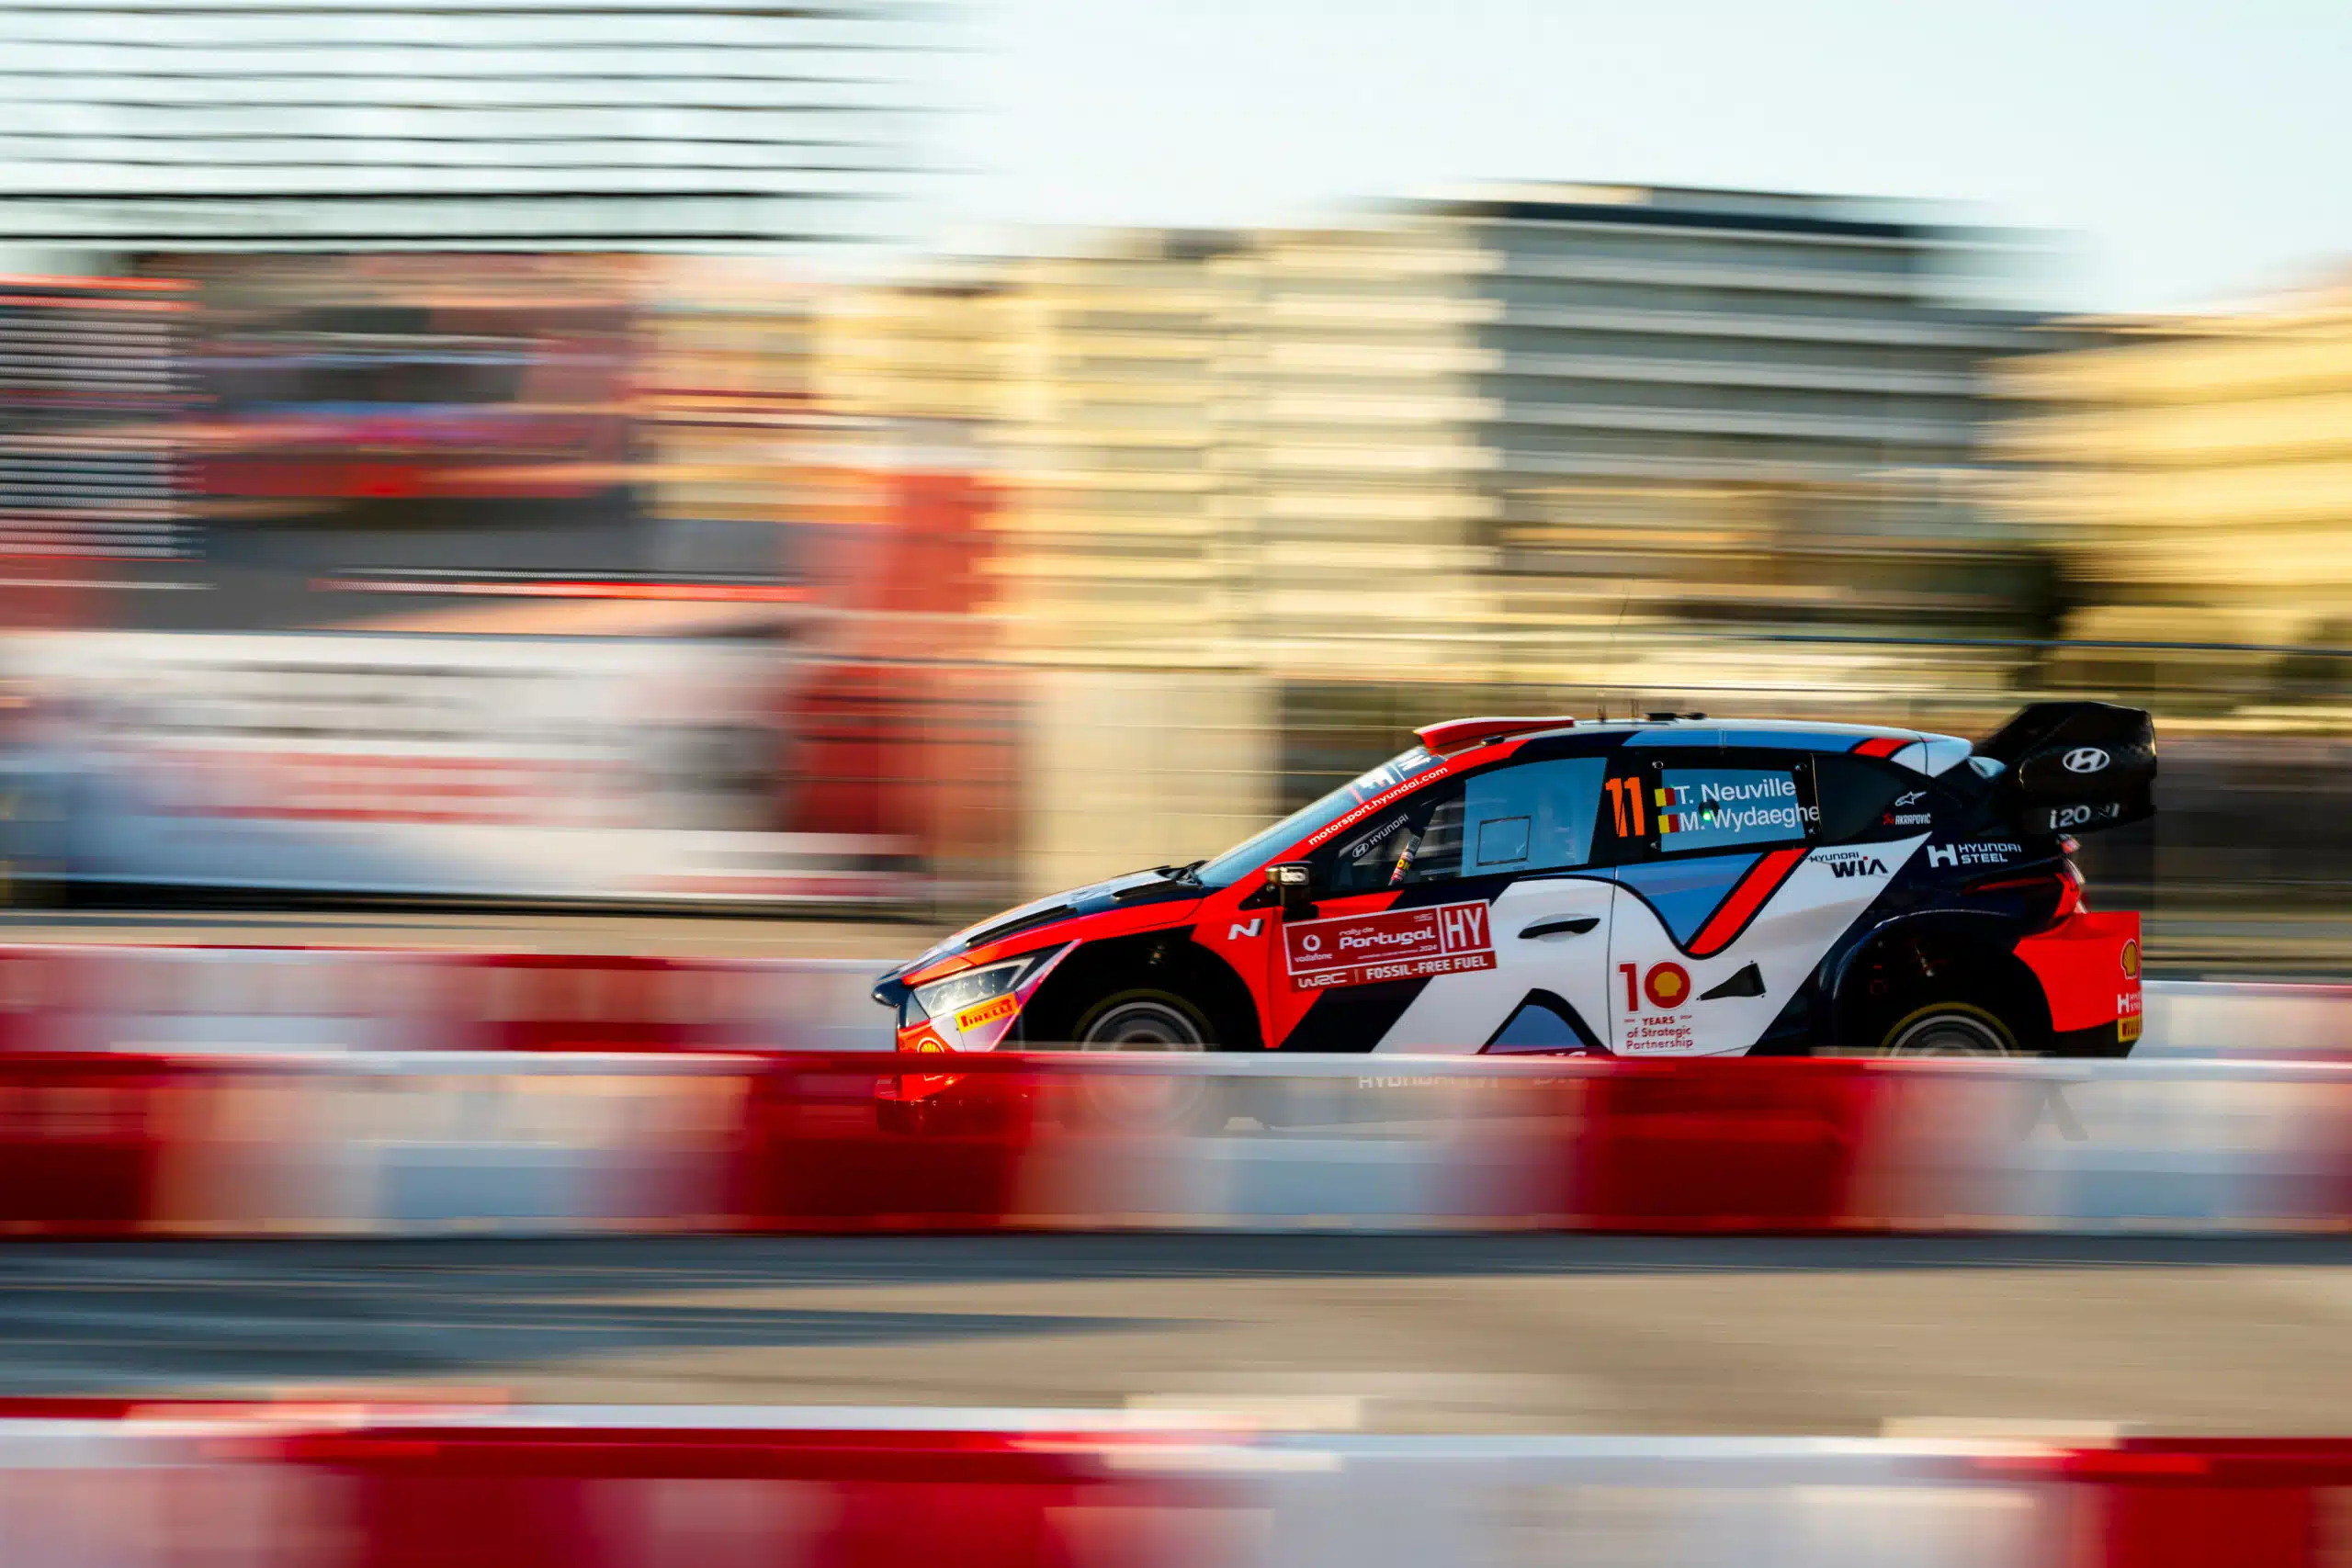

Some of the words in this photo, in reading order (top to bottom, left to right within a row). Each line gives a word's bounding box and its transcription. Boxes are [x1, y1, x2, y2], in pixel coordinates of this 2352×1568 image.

[1673, 785, 1694, 805] T.
[1702, 778, 1796, 803] Neuville
[1308, 766, 1448, 846] motorsport.hyundai.com
[1606, 777, 1645, 838] 11
[1679, 812, 1705, 831] M.
[1711, 803, 1820, 832] Wydaeghe
[2050, 805, 2091, 829] i20
[1370, 813, 1409, 846] HYUNDAI
[1809, 852, 1860, 863] HYUNDAI
[1959, 842, 2022, 854] HYUNDAI
[1961, 852, 2008, 864] STEEL
[1227, 919, 1264, 940] N
[1339, 926, 1437, 950] Portugal
[1443, 907, 1482, 949] HY
[1295, 953, 1333, 963] vodafone
[1366, 958, 1452, 980] FOSSIL-FREE
[1453, 956, 1488, 969] FUEL
[1297, 972, 1348, 988] WRC
[1619, 961, 1691, 1012] 10
[960, 998, 1013, 1027] PIRELLI
[1642, 1016, 1676, 1026] YEARS
[1625, 1037, 1694, 1050] Partnership
[1626, 1027, 1640, 1039] of
[1641, 1025, 1691, 1039] Strategic
